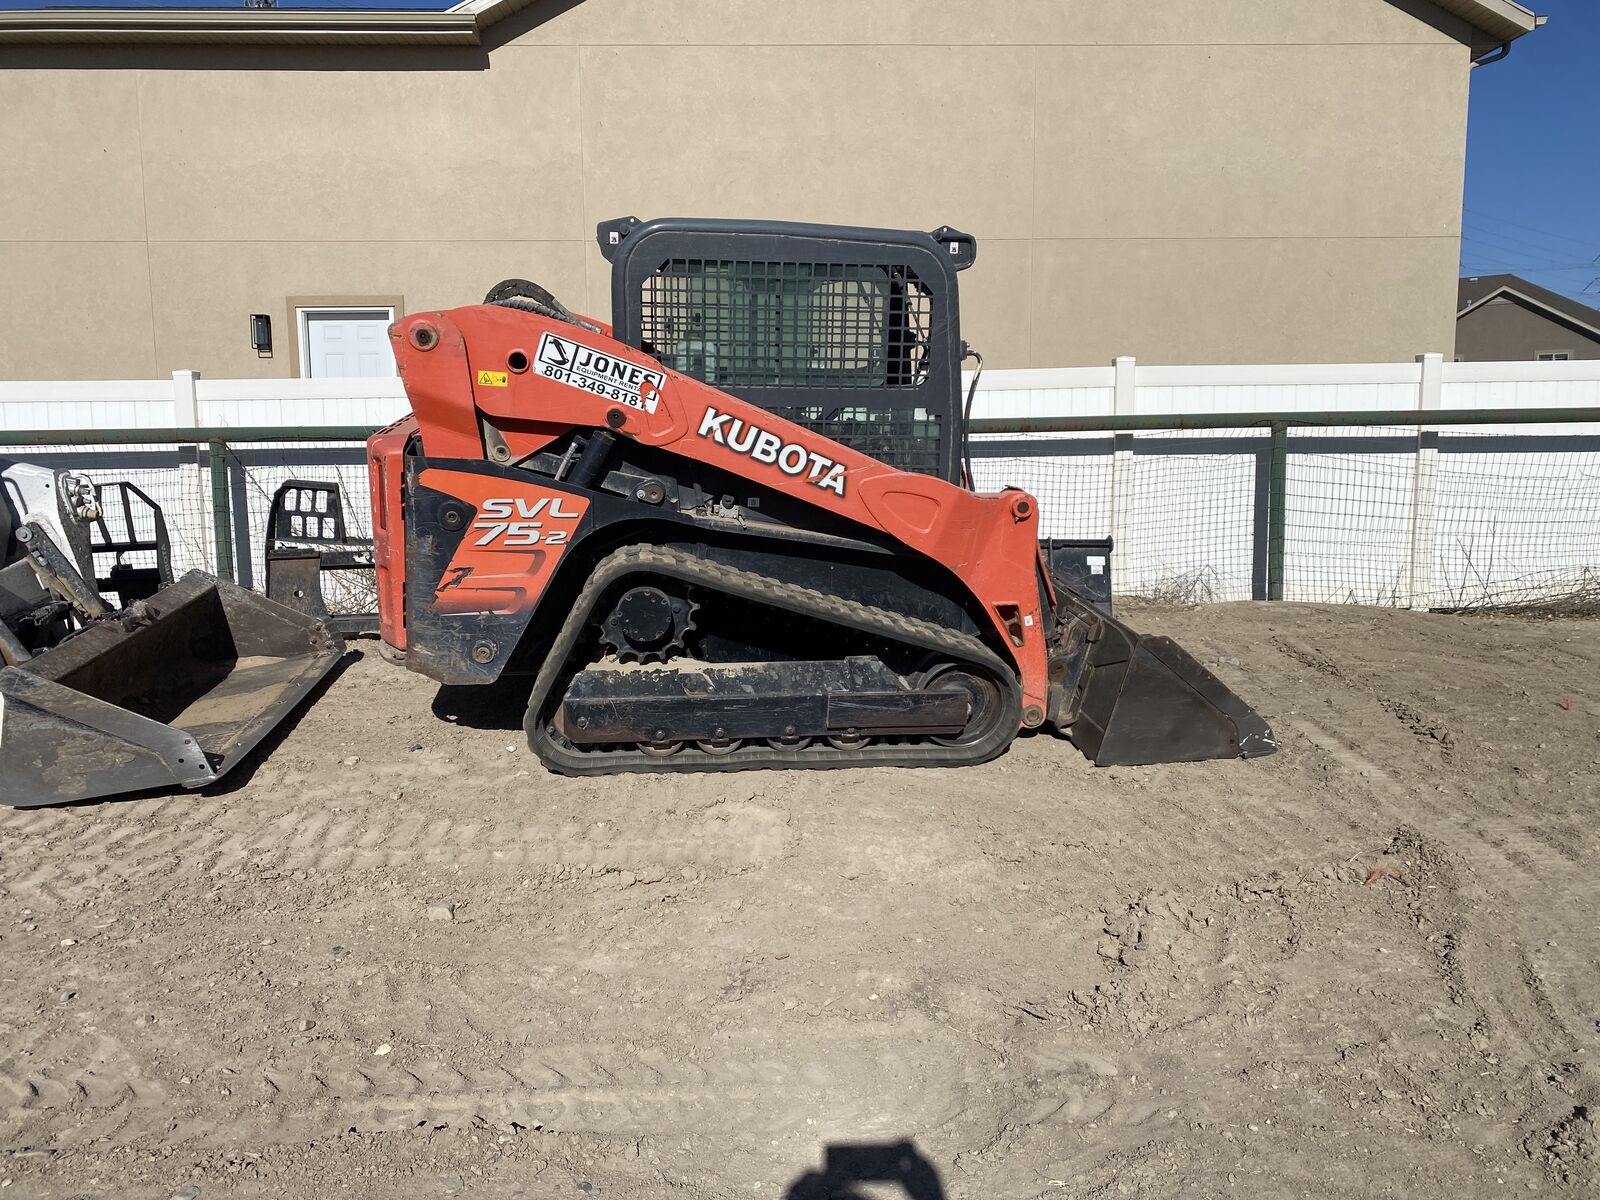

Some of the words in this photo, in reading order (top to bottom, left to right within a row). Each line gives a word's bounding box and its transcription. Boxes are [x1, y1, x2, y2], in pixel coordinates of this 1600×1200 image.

[576, 365, 618, 385] EQUIPMENT
[579, 352, 656, 386] JONES
[697, 406, 847, 497] KUBOTA
[478, 498, 579, 519] SVL
[473, 522, 567, 546] 75-2
